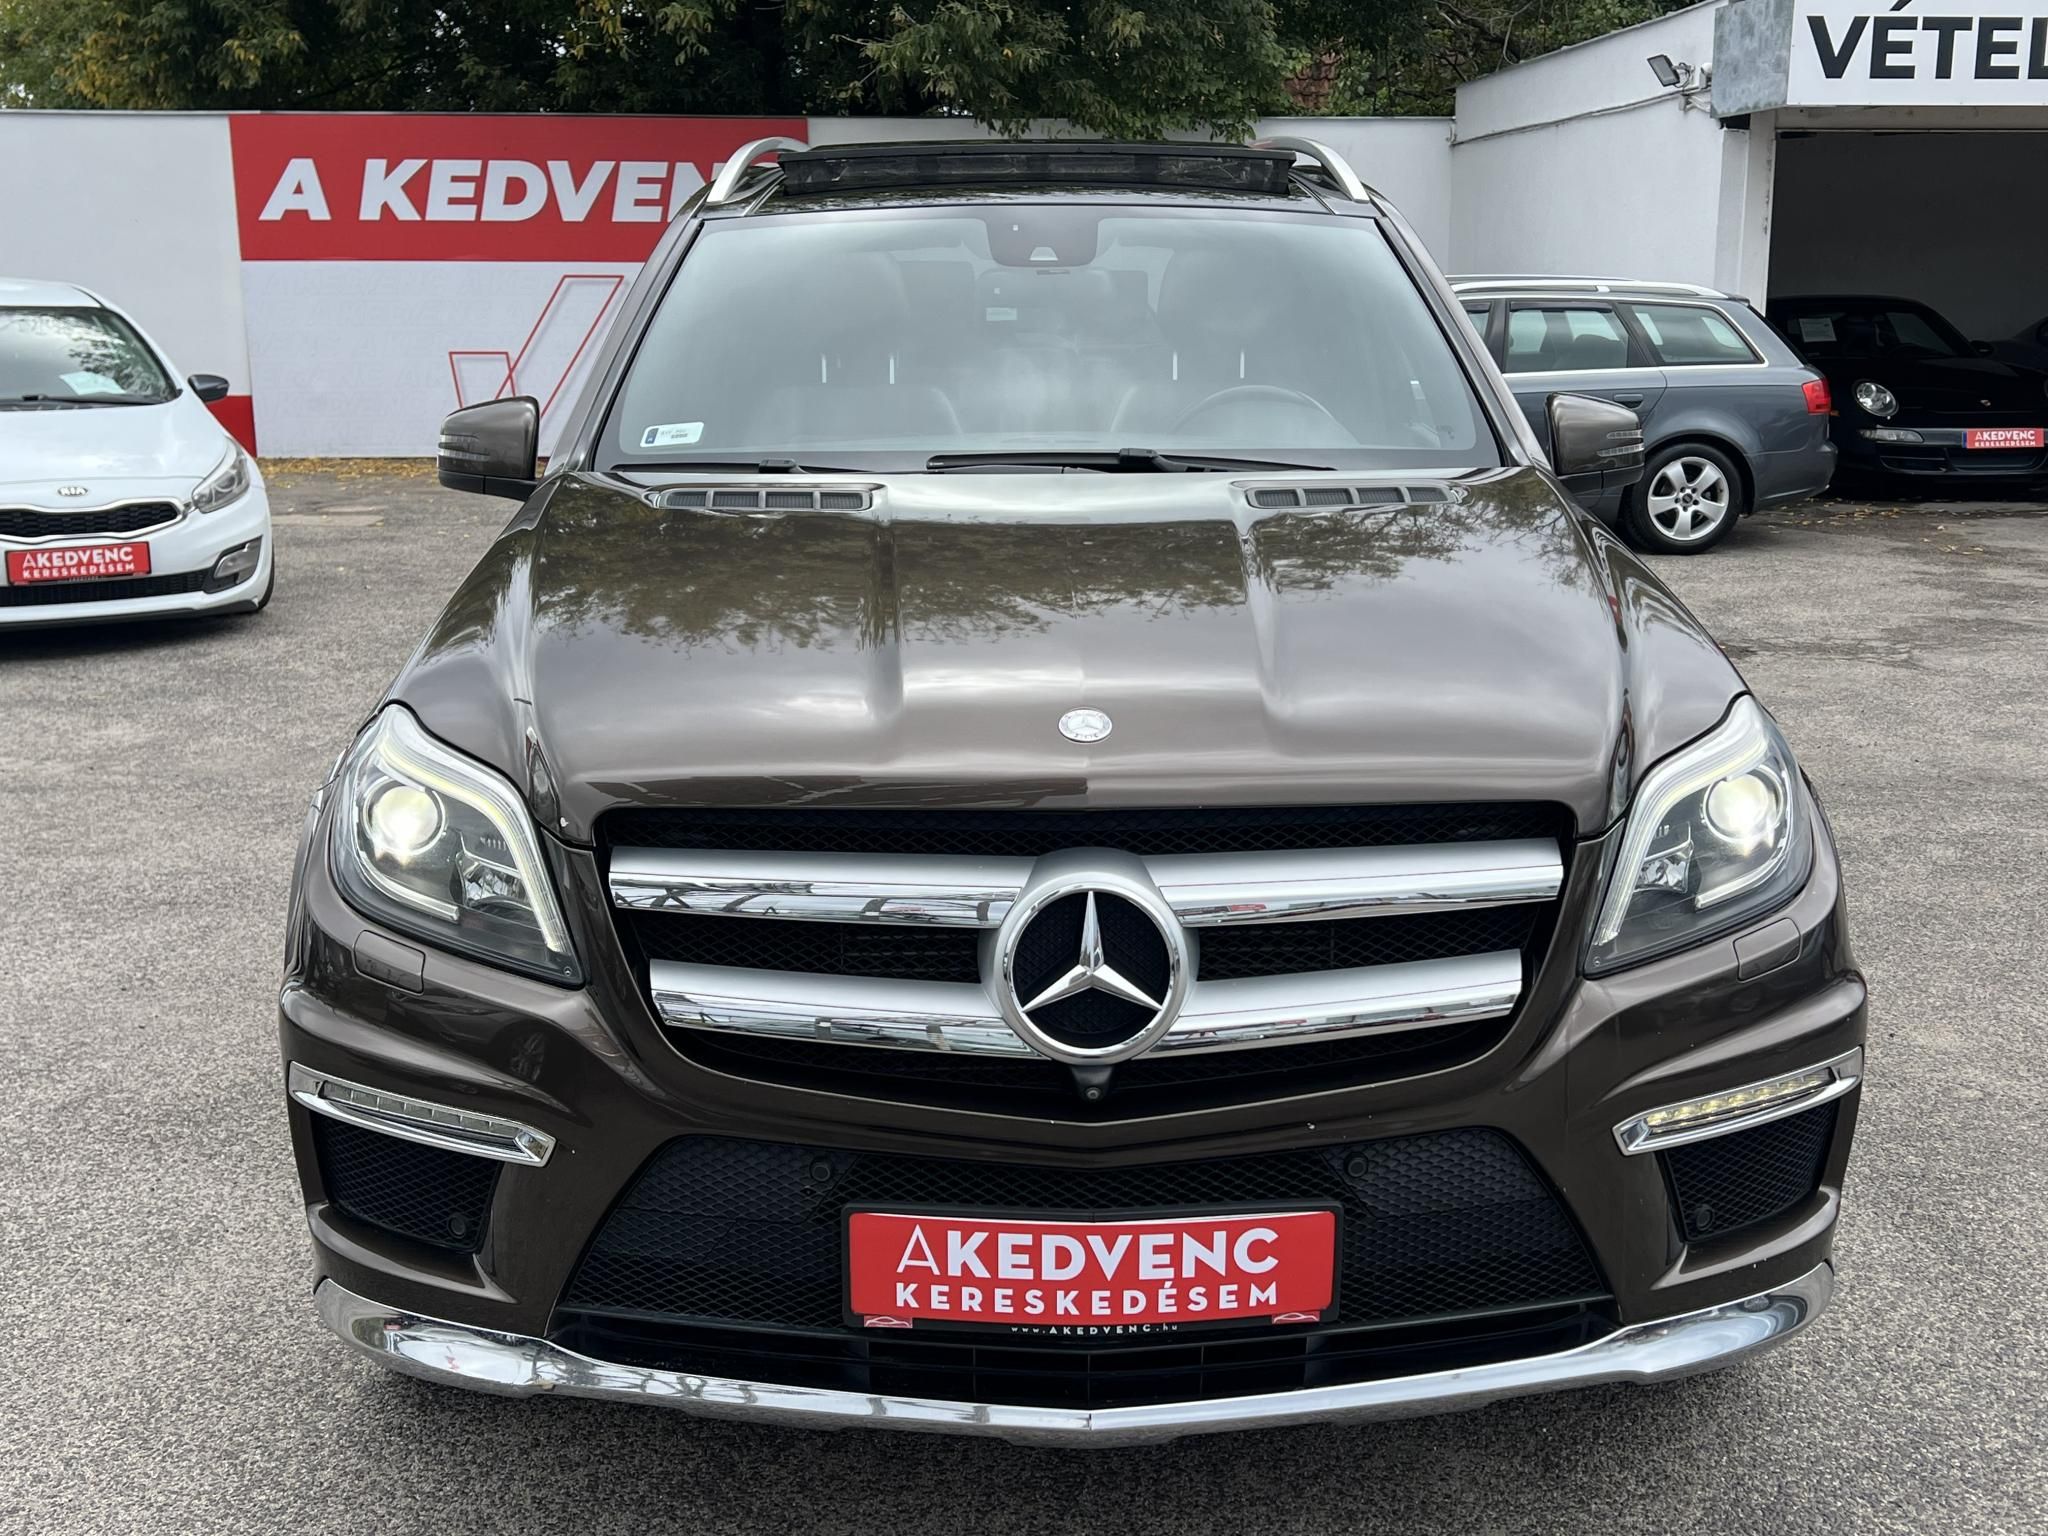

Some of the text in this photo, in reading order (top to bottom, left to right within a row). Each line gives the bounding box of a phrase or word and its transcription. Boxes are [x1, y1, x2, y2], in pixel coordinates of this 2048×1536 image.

[1807, 0, 2048, 80] VÉTEL
[258, 158, 778, 223] A KEDVEN
[1975, 431, 2035, 441] AKEDVENC
[23, 547, 133, 569] AKEDVENC
[23, 562, 135, 579] KERESKEDÉSEM
[896, 1223, 1279, 1282] AKEDVENC
[896, 1281, 1278, 1316] KERESKEDÉSEM
[1011, 1323, 1178, 1335] www.AKEDVENC.hu
